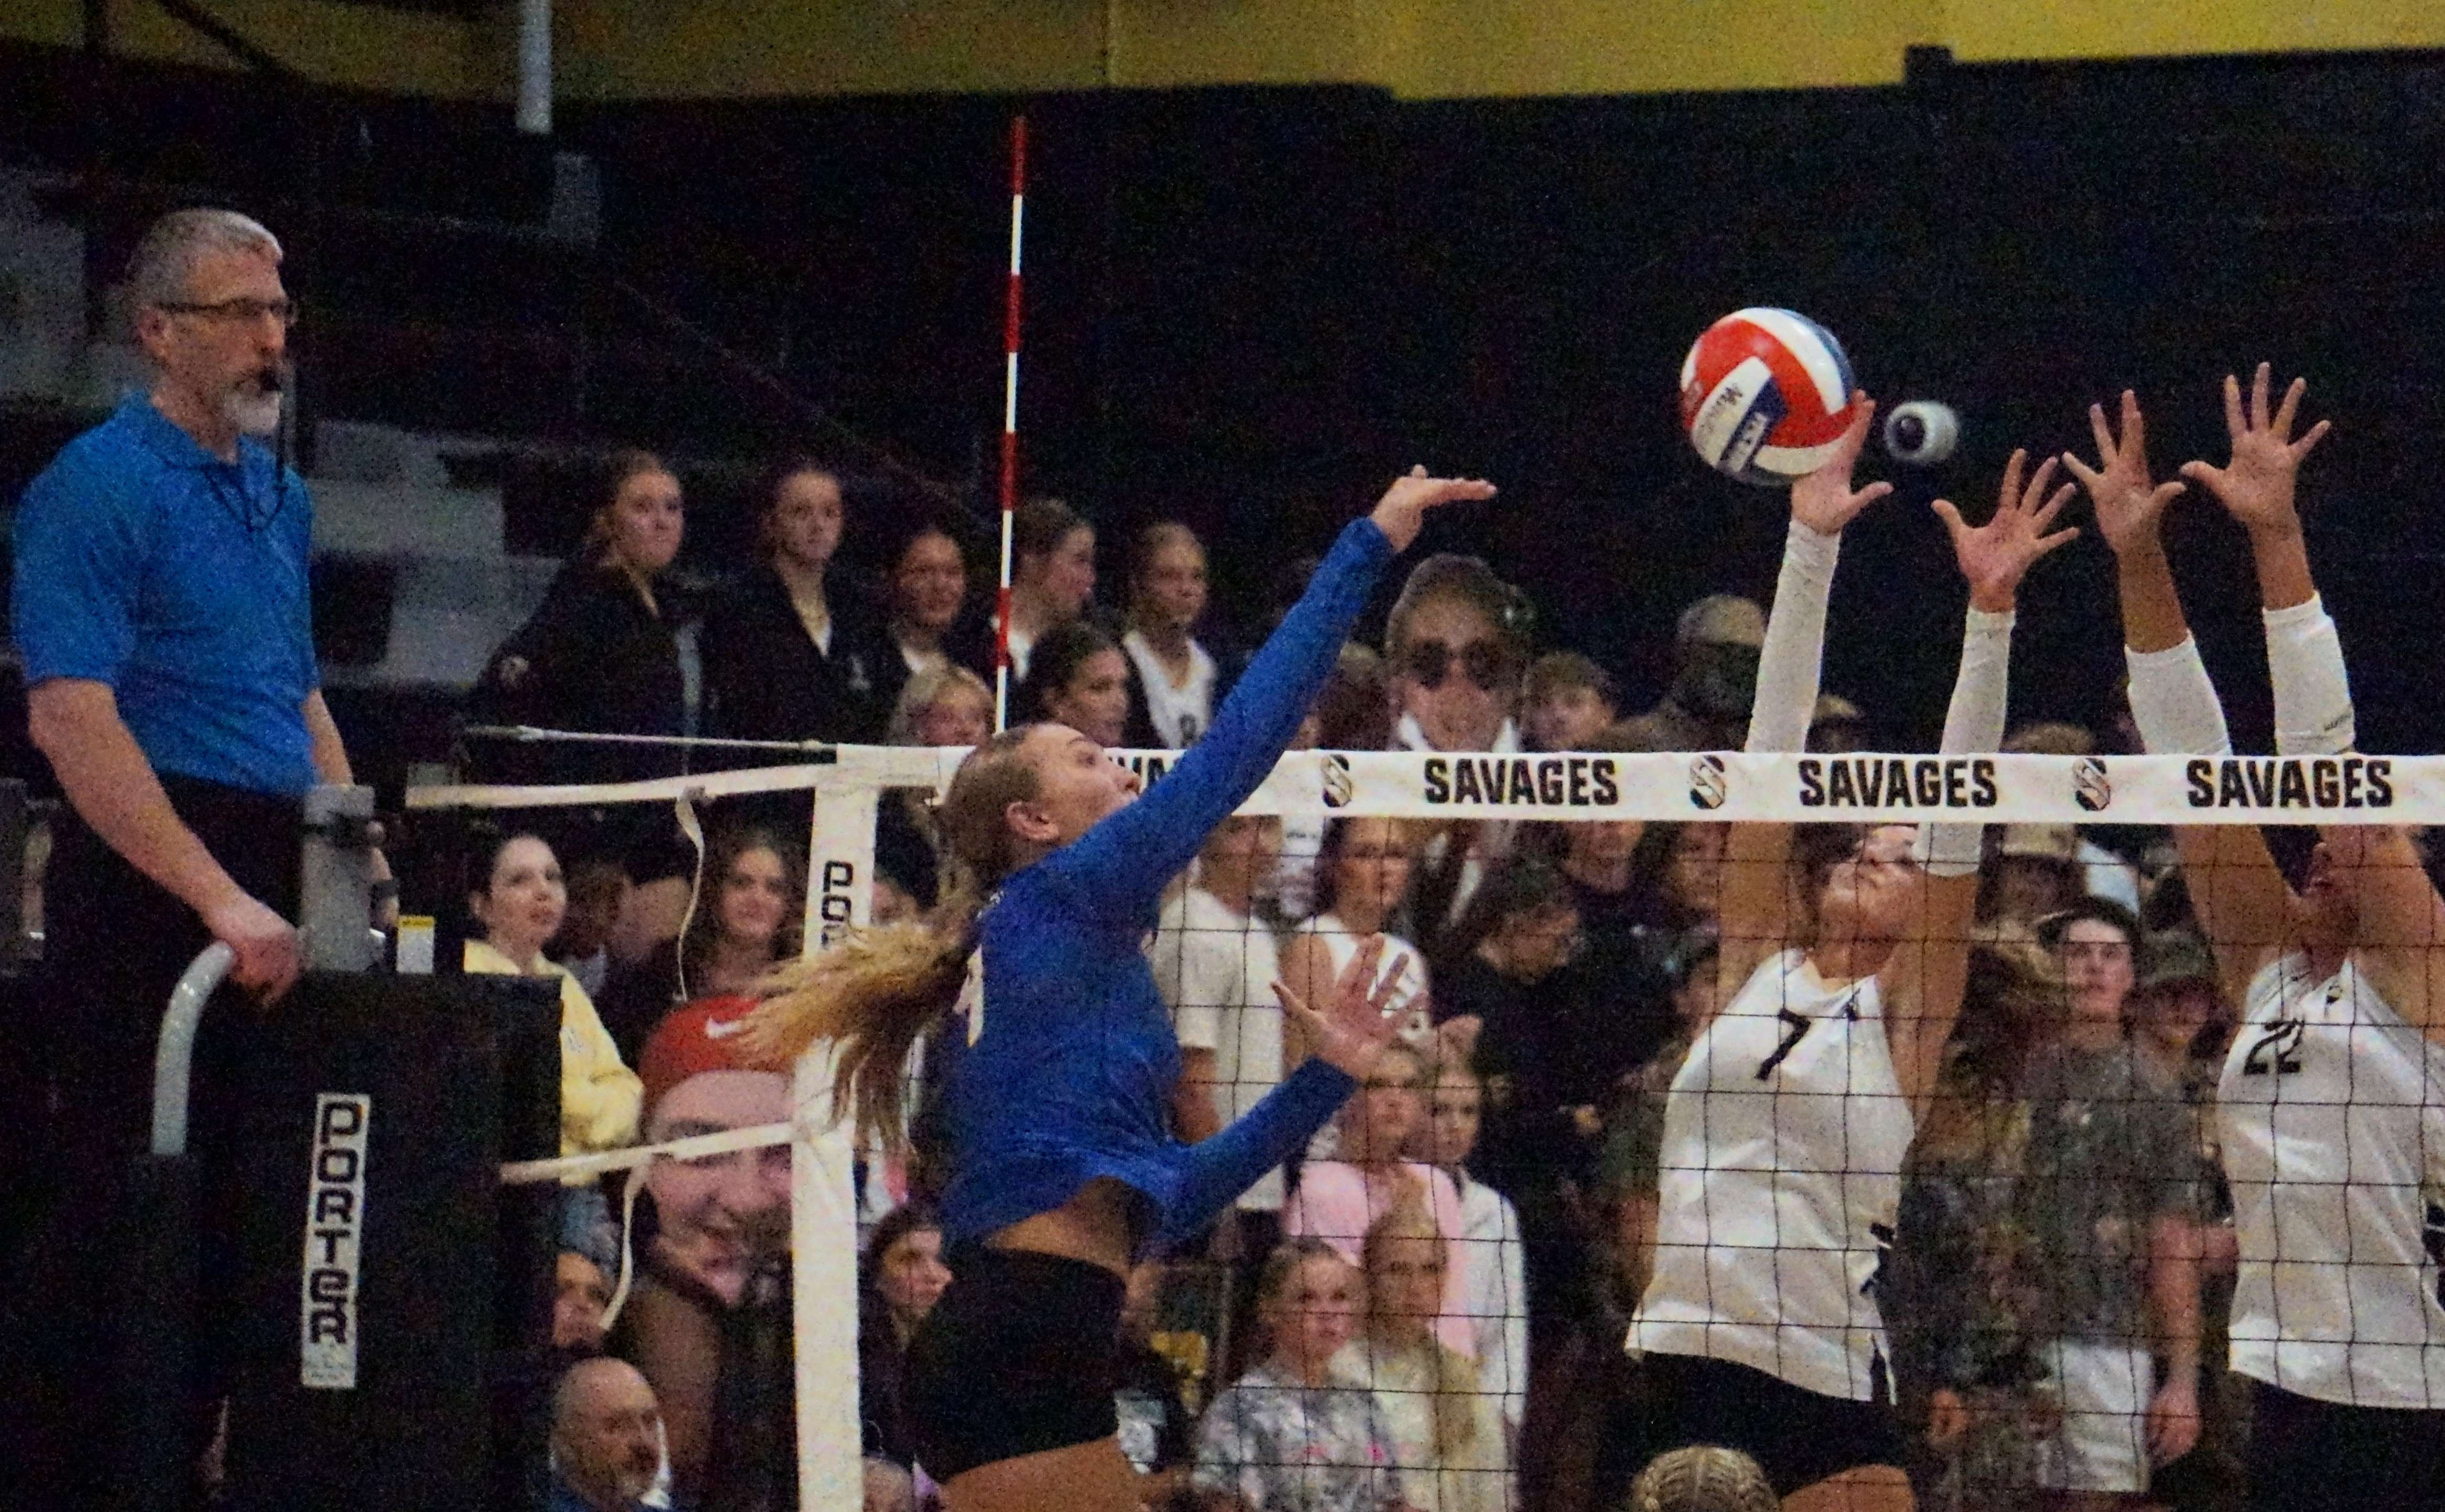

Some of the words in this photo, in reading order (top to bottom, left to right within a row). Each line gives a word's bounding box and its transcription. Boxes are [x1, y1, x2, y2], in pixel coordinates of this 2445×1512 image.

[1425, 759, 1618, 806] SAVAGES
[1798, 759, 1998, 807] SAVAGES
[2186, 759, 2394, 809] SAVAGES
[1756, 1007, 1811, 1081] 7
[2243, 1017, 2306, 1075] 22
[309, 1101, 363, 1344] PORTER
